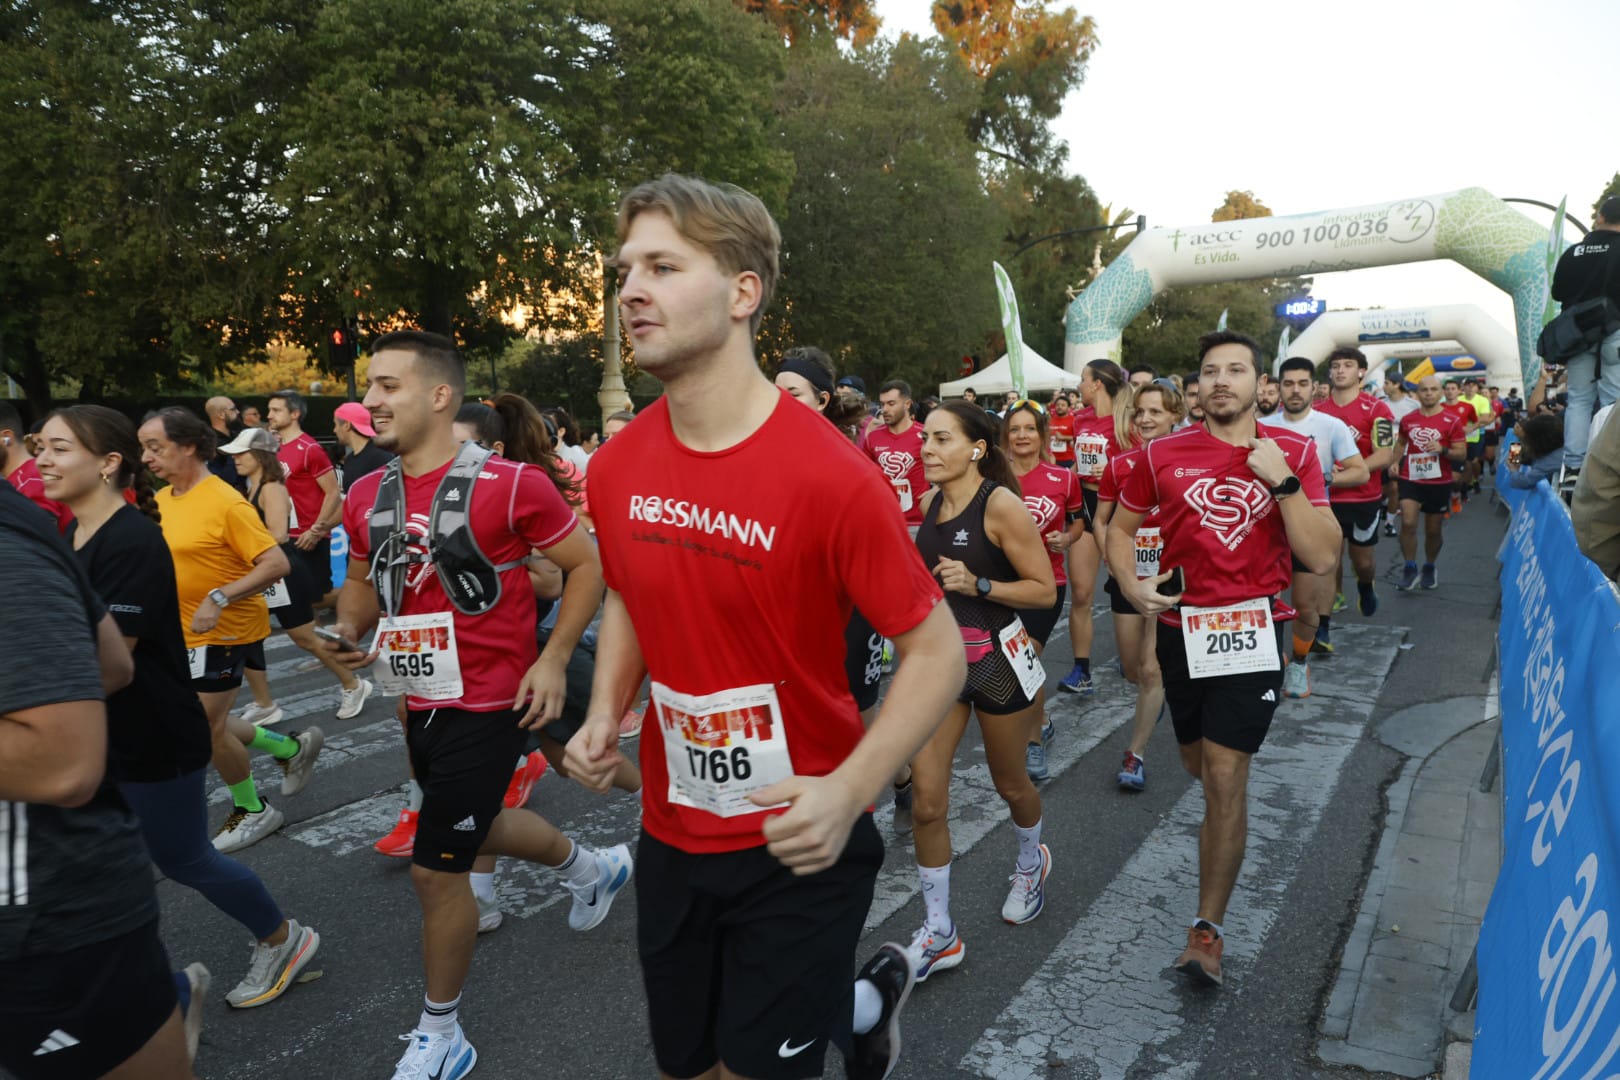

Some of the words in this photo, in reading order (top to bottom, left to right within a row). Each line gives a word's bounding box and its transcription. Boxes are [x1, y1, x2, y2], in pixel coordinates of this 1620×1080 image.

[1189, 229, 1242, 246] aecc
[1255, 229, 1295, 250] 900
[1303, 223, 1341, 244] 100
[1346, 216, 1389, 239] 036
[1194, 252, 1207, 265] Es
[629, 495, 776, 552] ROSSMANN
[1206, 629, 1258, 655] 2053
[389, 652, 435, 677] 1595
[685, 745, 752, 784] 1766
